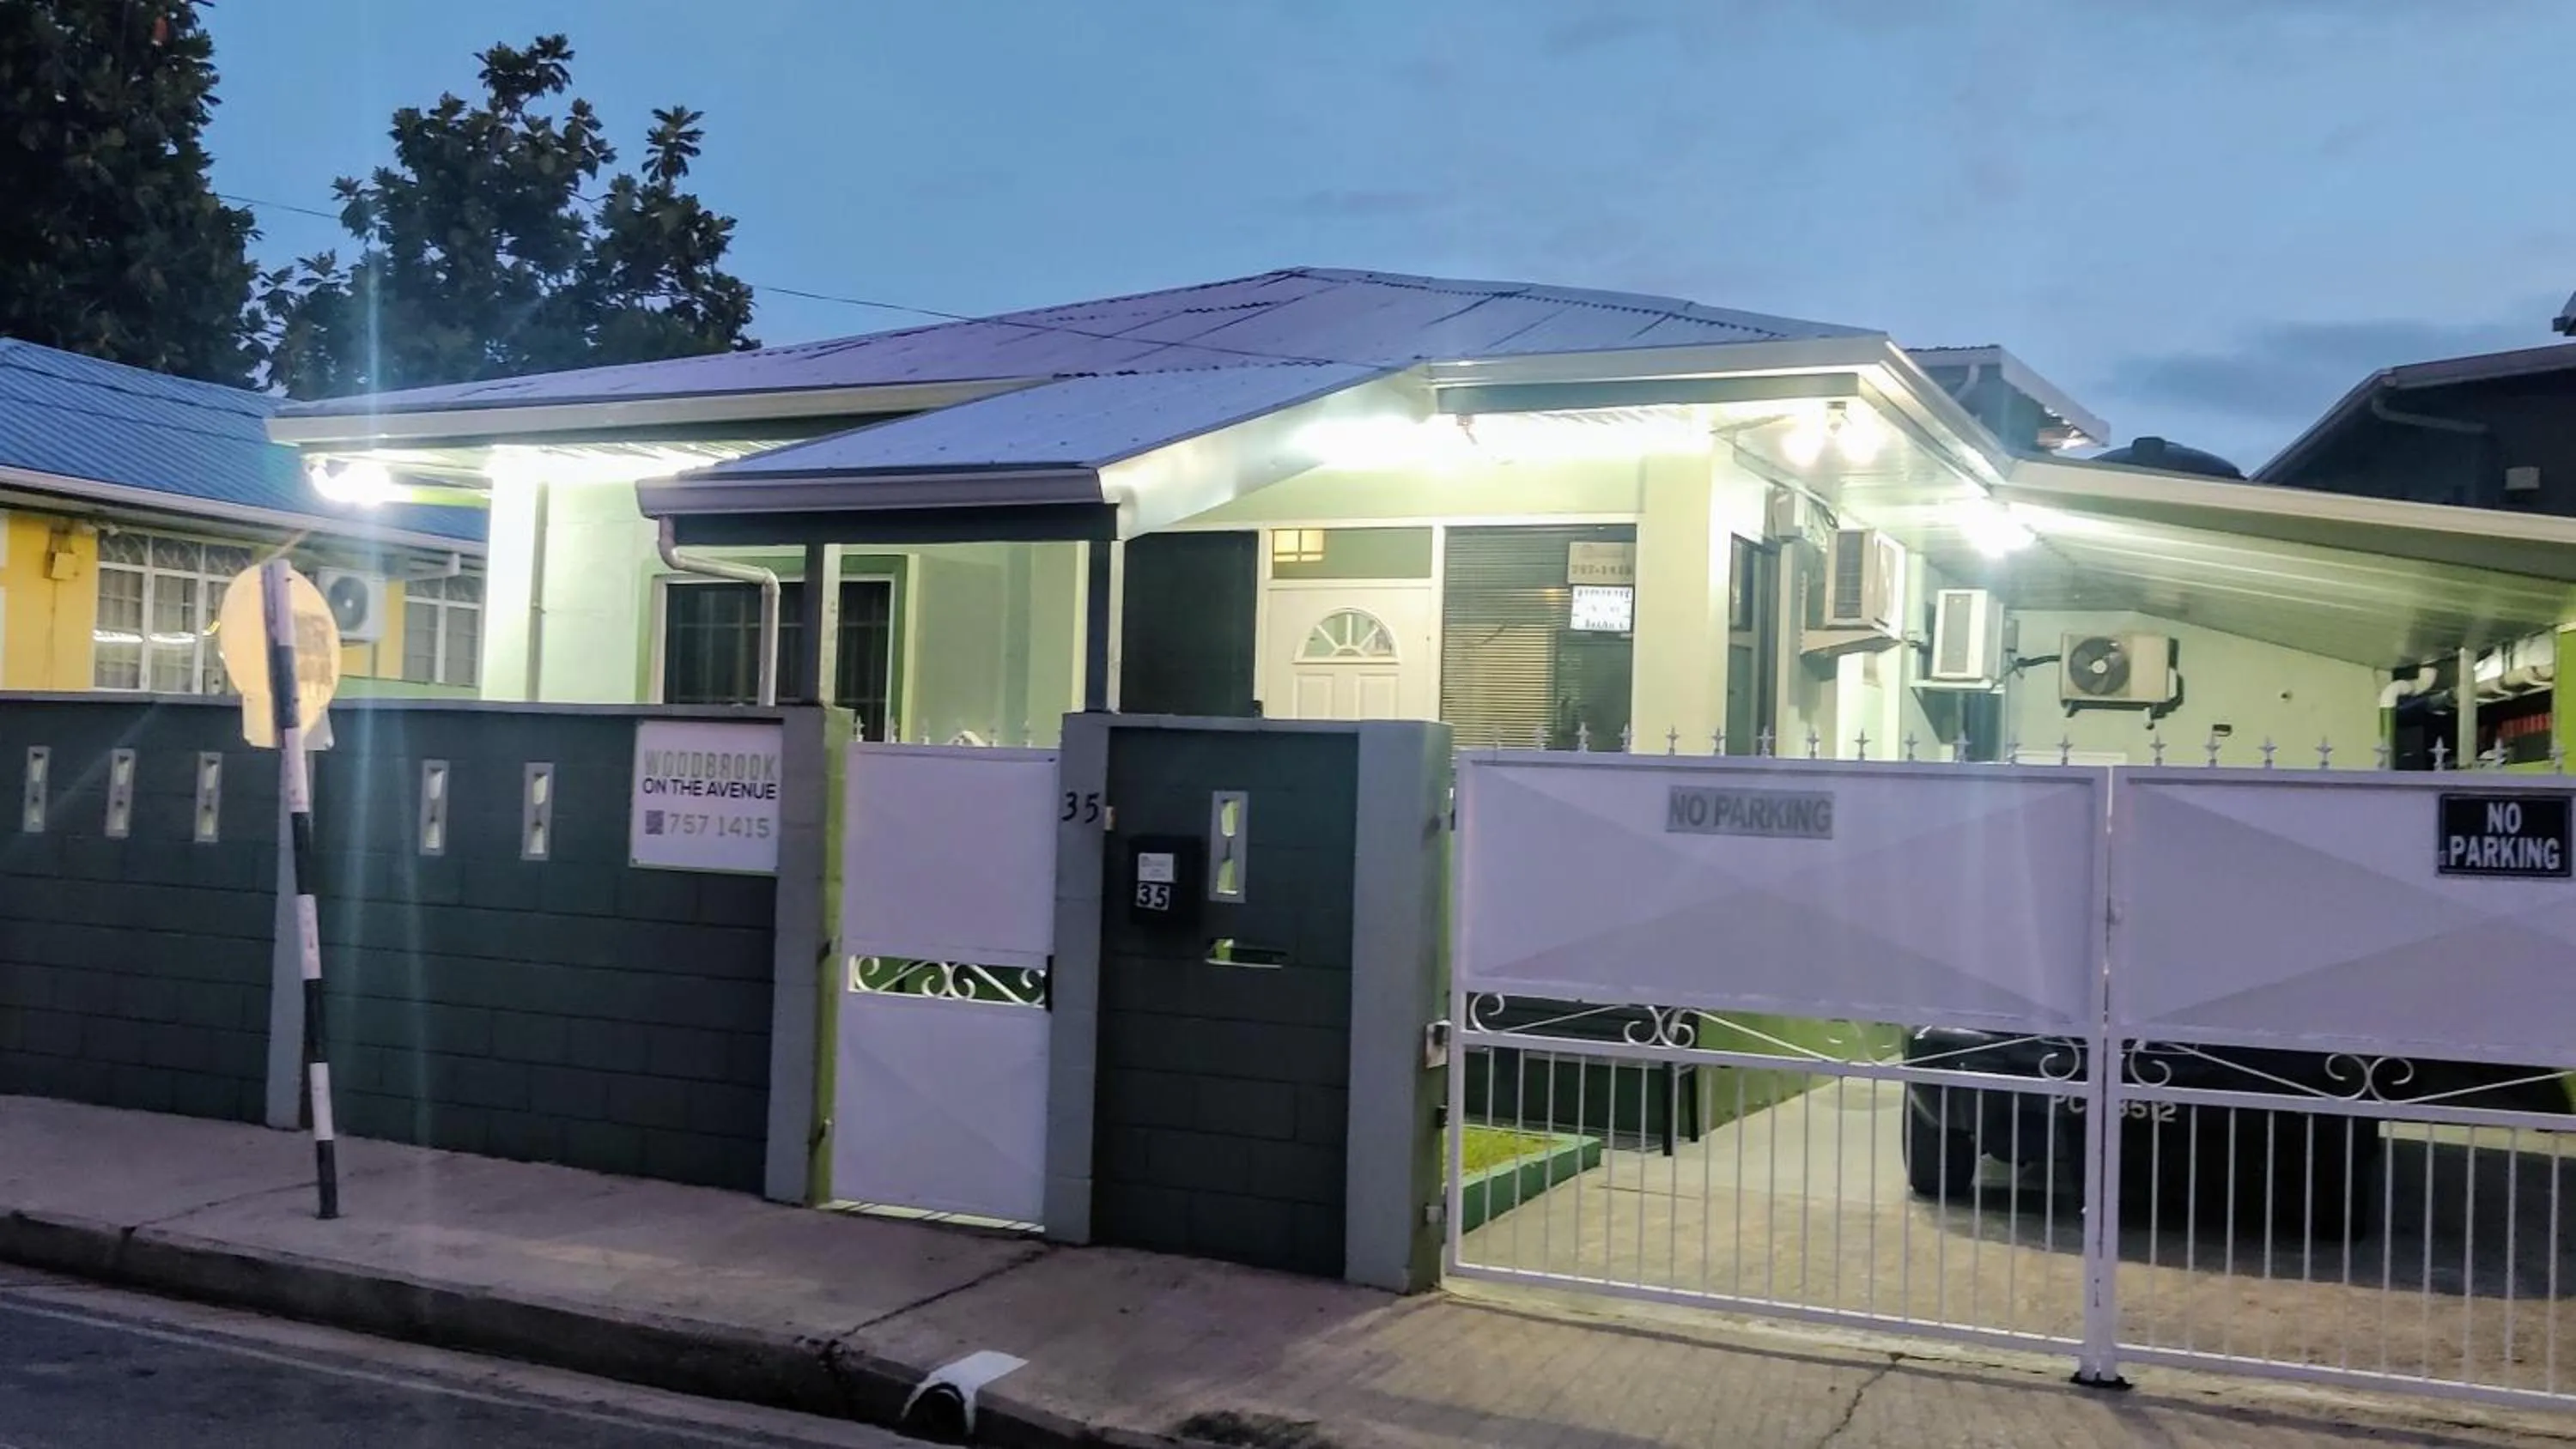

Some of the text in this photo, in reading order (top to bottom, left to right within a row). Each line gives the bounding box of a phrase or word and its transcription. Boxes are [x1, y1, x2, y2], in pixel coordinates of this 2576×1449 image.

[645, 751, 776, 779] WOODBROOK
[643, 778, 777, 799] ON THE AVENUE
[1061, 791, 1100, 824] 35
[1670, 793, 1832, 833] NO PARKING
[2487, 802, 2523, 834] NO
[671, 814, 770, 839] 757 1415
[2449, 835, 2561, 870] PARKING
[1139, 884, 1167, 907] 35
